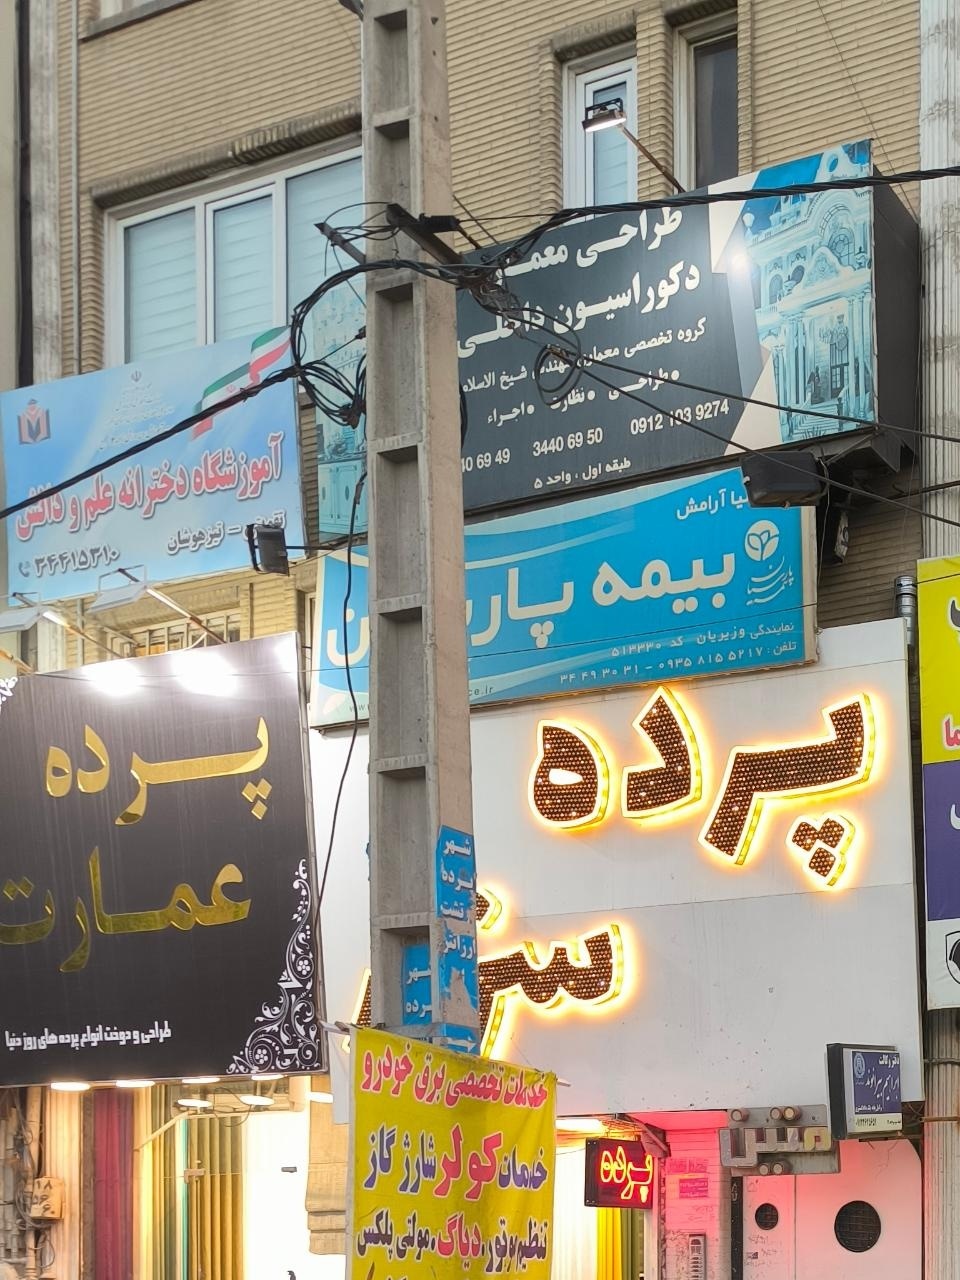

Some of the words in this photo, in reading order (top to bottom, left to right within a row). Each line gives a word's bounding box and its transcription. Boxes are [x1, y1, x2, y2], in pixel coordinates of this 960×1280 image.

[576, 206, 683, 269] طراحی
[553, 259, 701, 336] دکوراسیون
[624, 329, 673, 359] تخصصی
[494, 447, 511, 466] 49
[532, 436, 564, 457] 3440
[567, 432, 584, 450] 69
[586, 427, 604, 446] 50
[630, 414, 664, 436] 0912
[695, 398, 730, 421] 9274
[118, 460, 191, 519] دخترانه
[191, 430, 284, 501] آموزشگاه
[545, 468, 572, 488] واحد
[581, 462, 602, 482] اول
[605, 457, 632, 475] طبقه
[68, 502, 81, 533] و
[83, 473, 115, 530] علم
[675, 487, 727, 520] آرامش
[166, 521, 225, 555] تیزهوشان
[591, 546, 737, 615] بیمه
[45, 715, 274, 826] پرده
[527, 685, 878, 888] پرده
[0, 845, 252, 974] عمارت
[4, 1030, 22, 1051] دنیا
[22, 1031, 37, 1051] روز
[37, 1027, 58, 1050] های
[58, 1033, 79, 1051] پرده
[80, 1024, 103, 1048] انواع
[103, 1026, 131, 1046] دوخت
[132, 1030, 140, 1045] و
[141, 1019, 172, 1044] طراحی
[361, 1043, 414, 1097] خودرو
[414, 1053, 447, 1104] برق
[444, 1062, 504, 1109] تخصصی
[362, 1122, 398, 1190] گاز
[397, 1130, 437, 1194] شارژ
[432, 1122, 503, 1201] کولر
[498, 1146, 549, 1191] خدمات
[600, 1145, 654, 1204] پرده
[396, 1213, 431, 1261] مولتی
[437, 1213, 482, 1270] دیاگ
